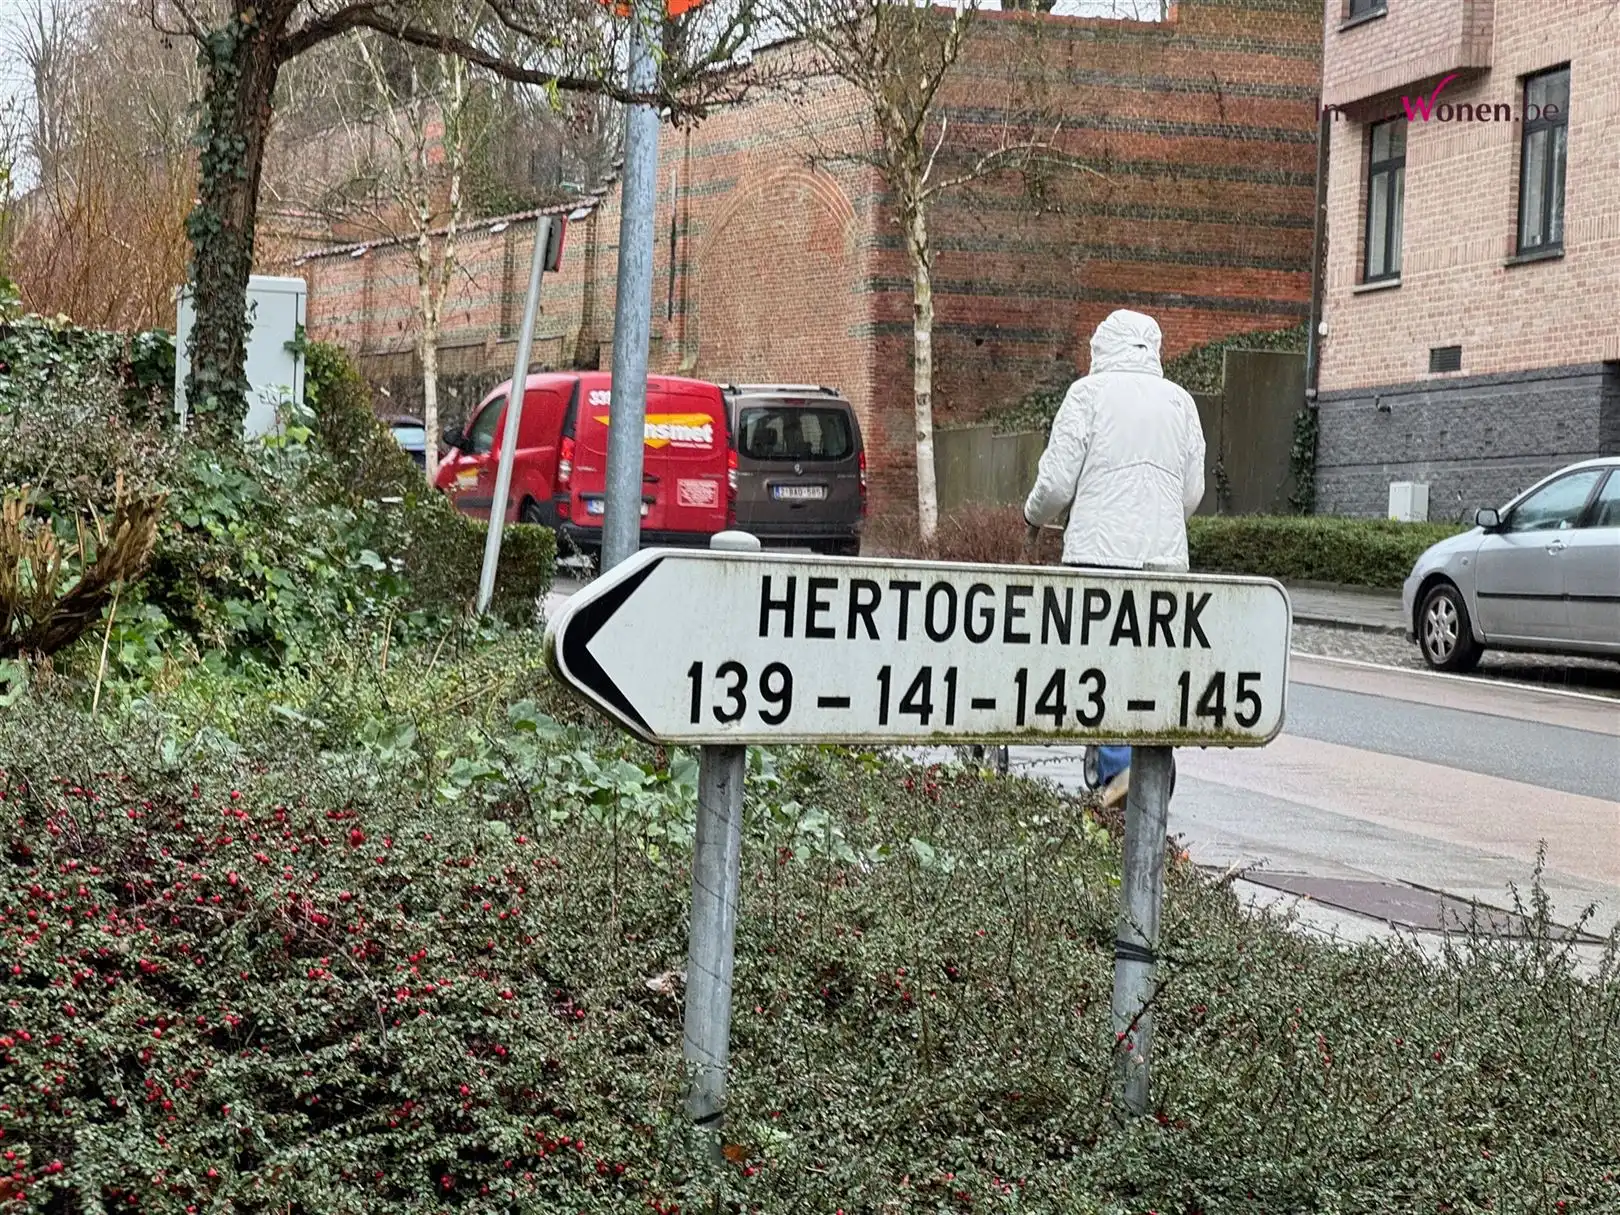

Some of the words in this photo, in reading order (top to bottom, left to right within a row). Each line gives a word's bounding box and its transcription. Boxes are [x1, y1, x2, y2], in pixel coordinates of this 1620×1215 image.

[758, 575, 1213, 649] HERTOGENPARK
[687, 660, 794, 727] 139
[876, 665, 958, 727] 141
[1014, 666, 1107, 729] 143
[1177, 669, 1263, 729] 145
